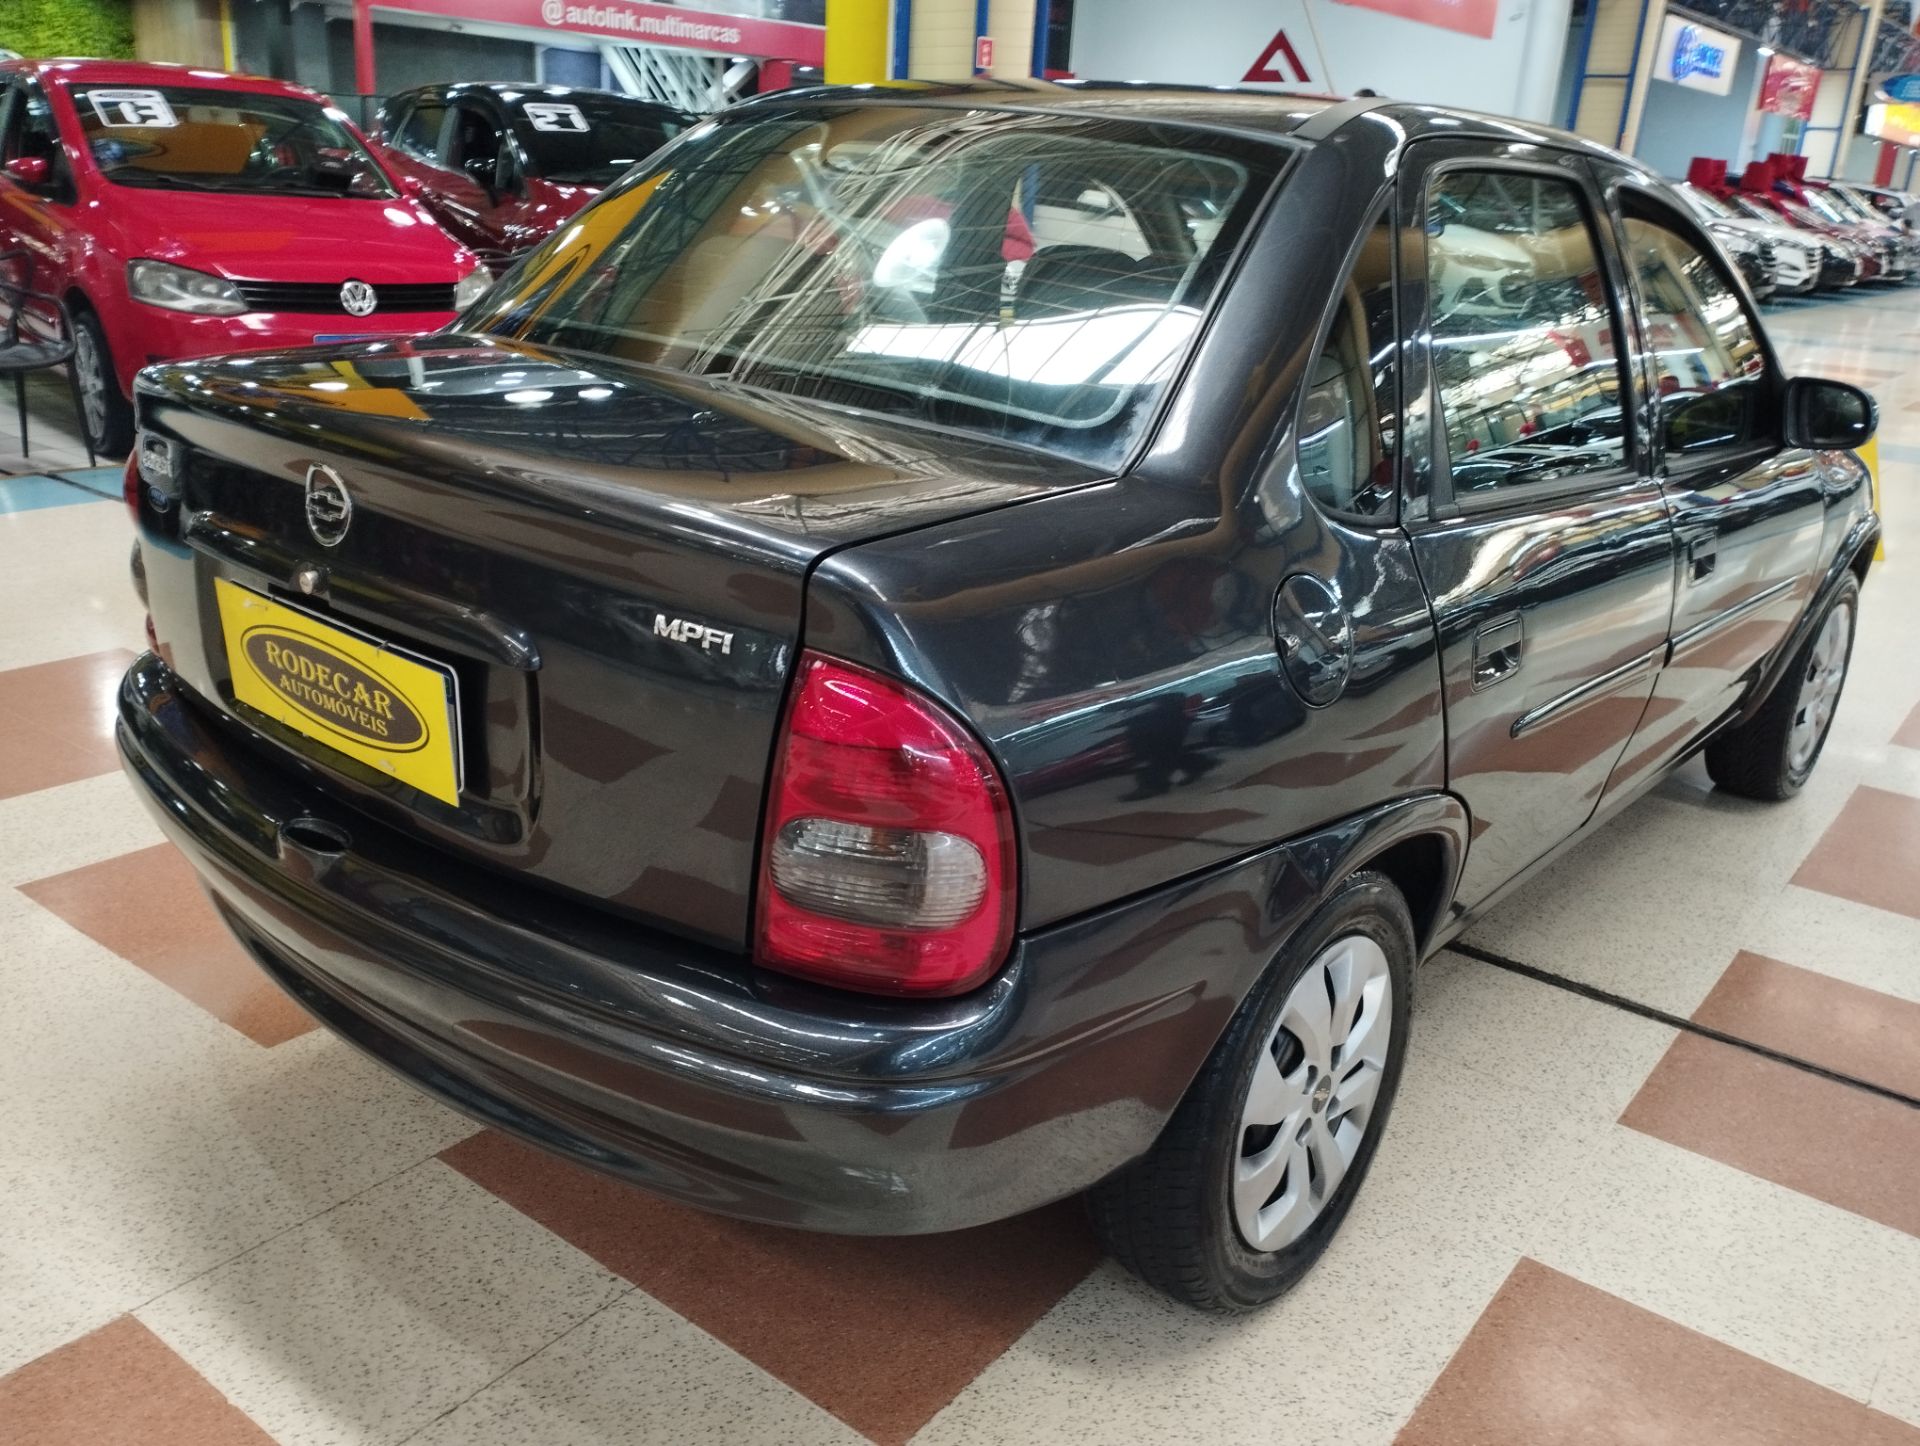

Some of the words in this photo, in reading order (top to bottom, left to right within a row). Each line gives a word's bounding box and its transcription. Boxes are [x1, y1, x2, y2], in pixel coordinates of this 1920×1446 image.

[653, 613, 734, 655] MPFI
[265, 640, 395, 720] RODECAR
[279, 674, 389, 737] AUTOMÓVEIS
